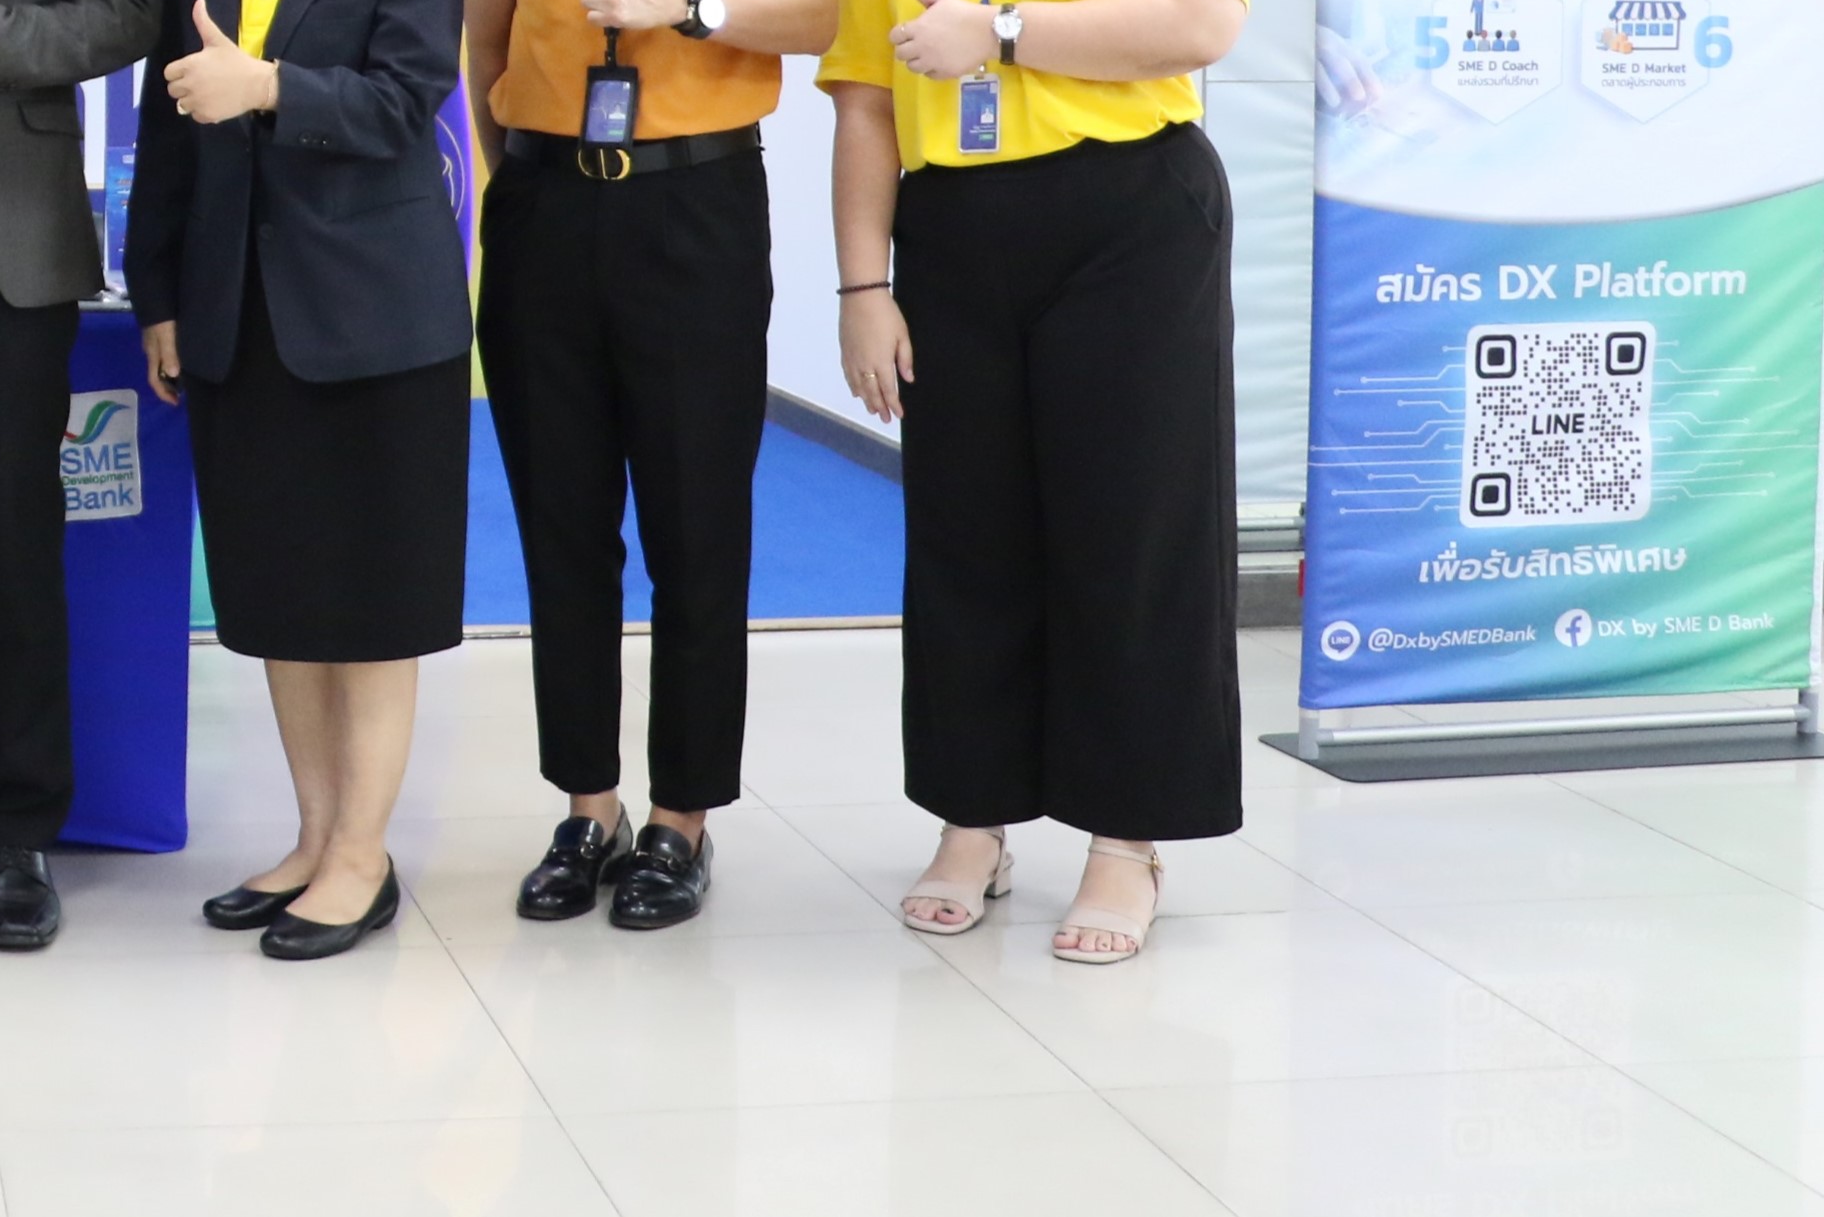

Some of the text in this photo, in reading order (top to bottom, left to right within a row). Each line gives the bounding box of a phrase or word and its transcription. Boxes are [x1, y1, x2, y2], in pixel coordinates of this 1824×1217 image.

[1414, 16, 1450, 70] 5
[1693, 16, 1733, 68] 6
[1458, 60, 1539, 72] SME D Coach
[1602, 63, 1686, 74] SME D Market
[1375, 264, 1482, 303] สมัคร
[1499, 260, 1747, 300] DX Platform
[1531, 413, 1586, 437] LINE
[61, 442, 133, 475] SME
[62, 472, 134, 487] Development
[64, 483, 134, 512] Bank
[1419, 541, 1687, 583] เพื่อรับสิทธิพิเศษ
[1368, 625, 1536, 652] @DxbySMEDBank
[1598, 613, 1774, 638] DX by SME D Bank
